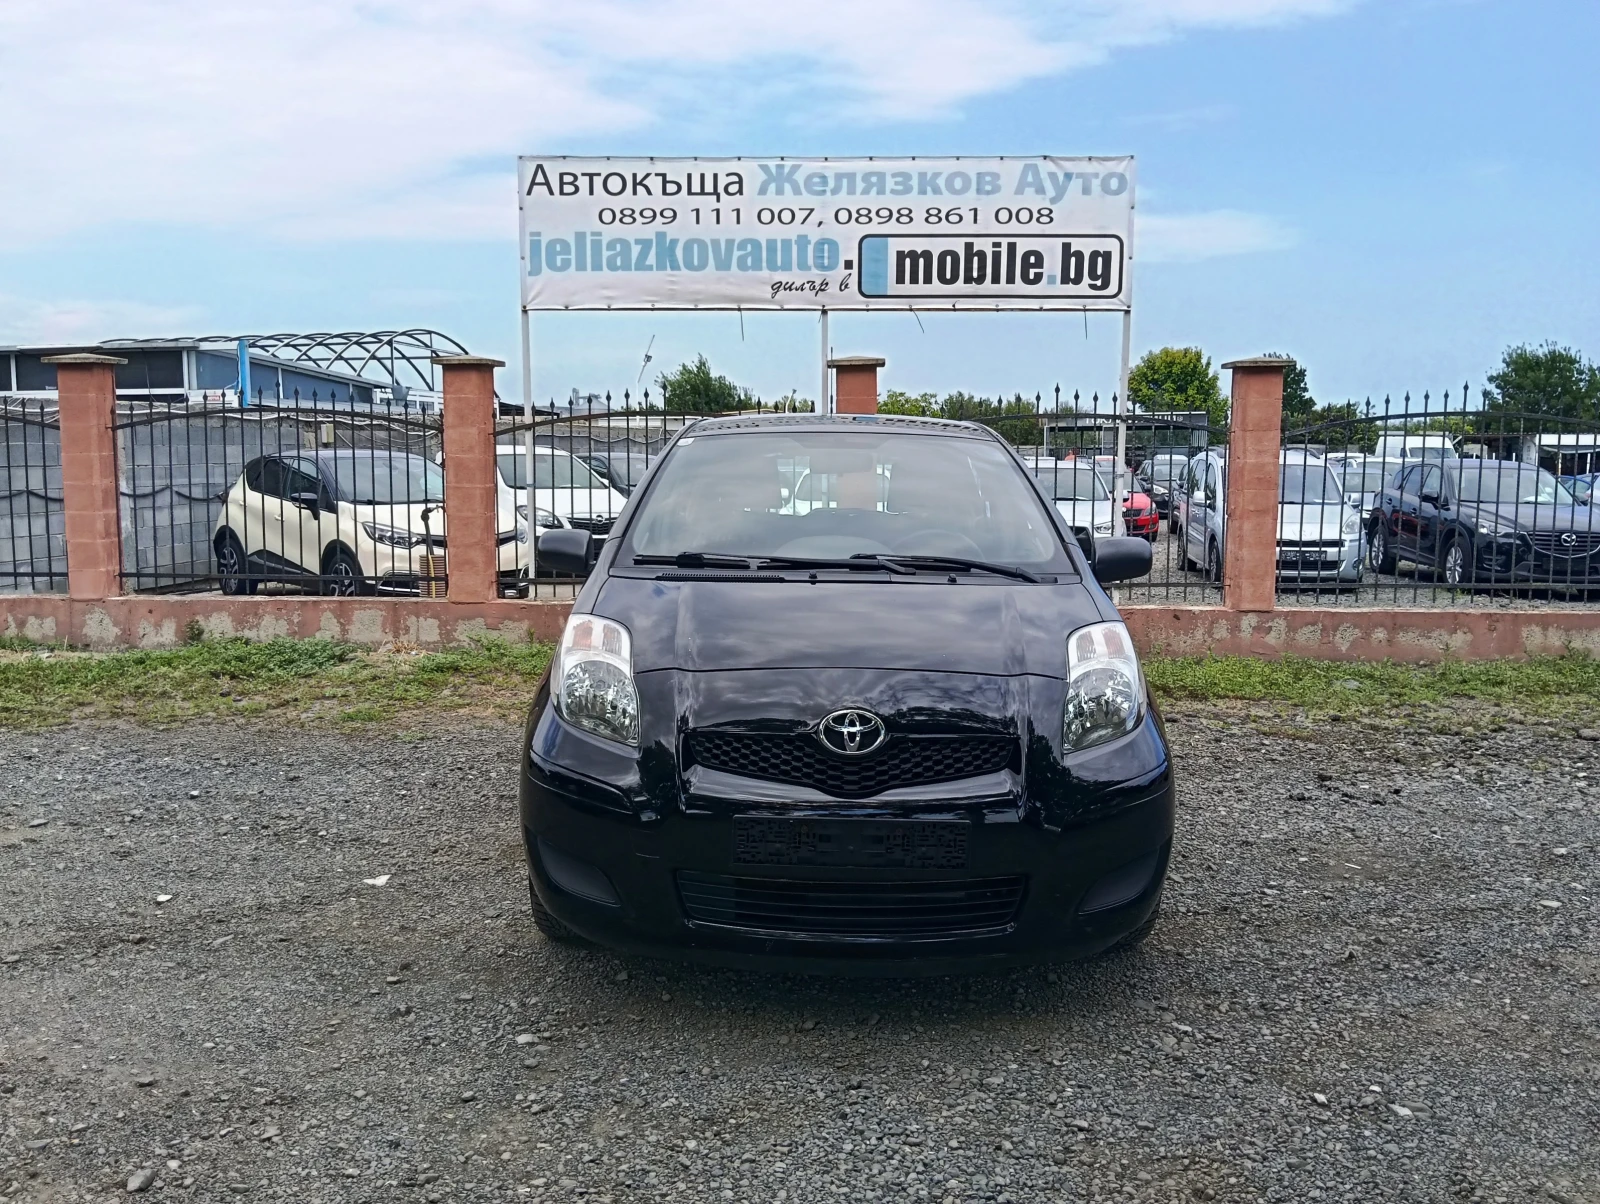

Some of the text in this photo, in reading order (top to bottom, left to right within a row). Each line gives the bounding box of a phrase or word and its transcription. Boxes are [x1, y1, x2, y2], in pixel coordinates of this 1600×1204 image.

[526, 163, 1128, 205] Автокъща Желязков Ауто
[598, 207, 1054, 227] 0899 111 007, 0898 861 008
[895, 242, 1112, 291] mobile.bg
[771, 278, 830, 299] дилър
